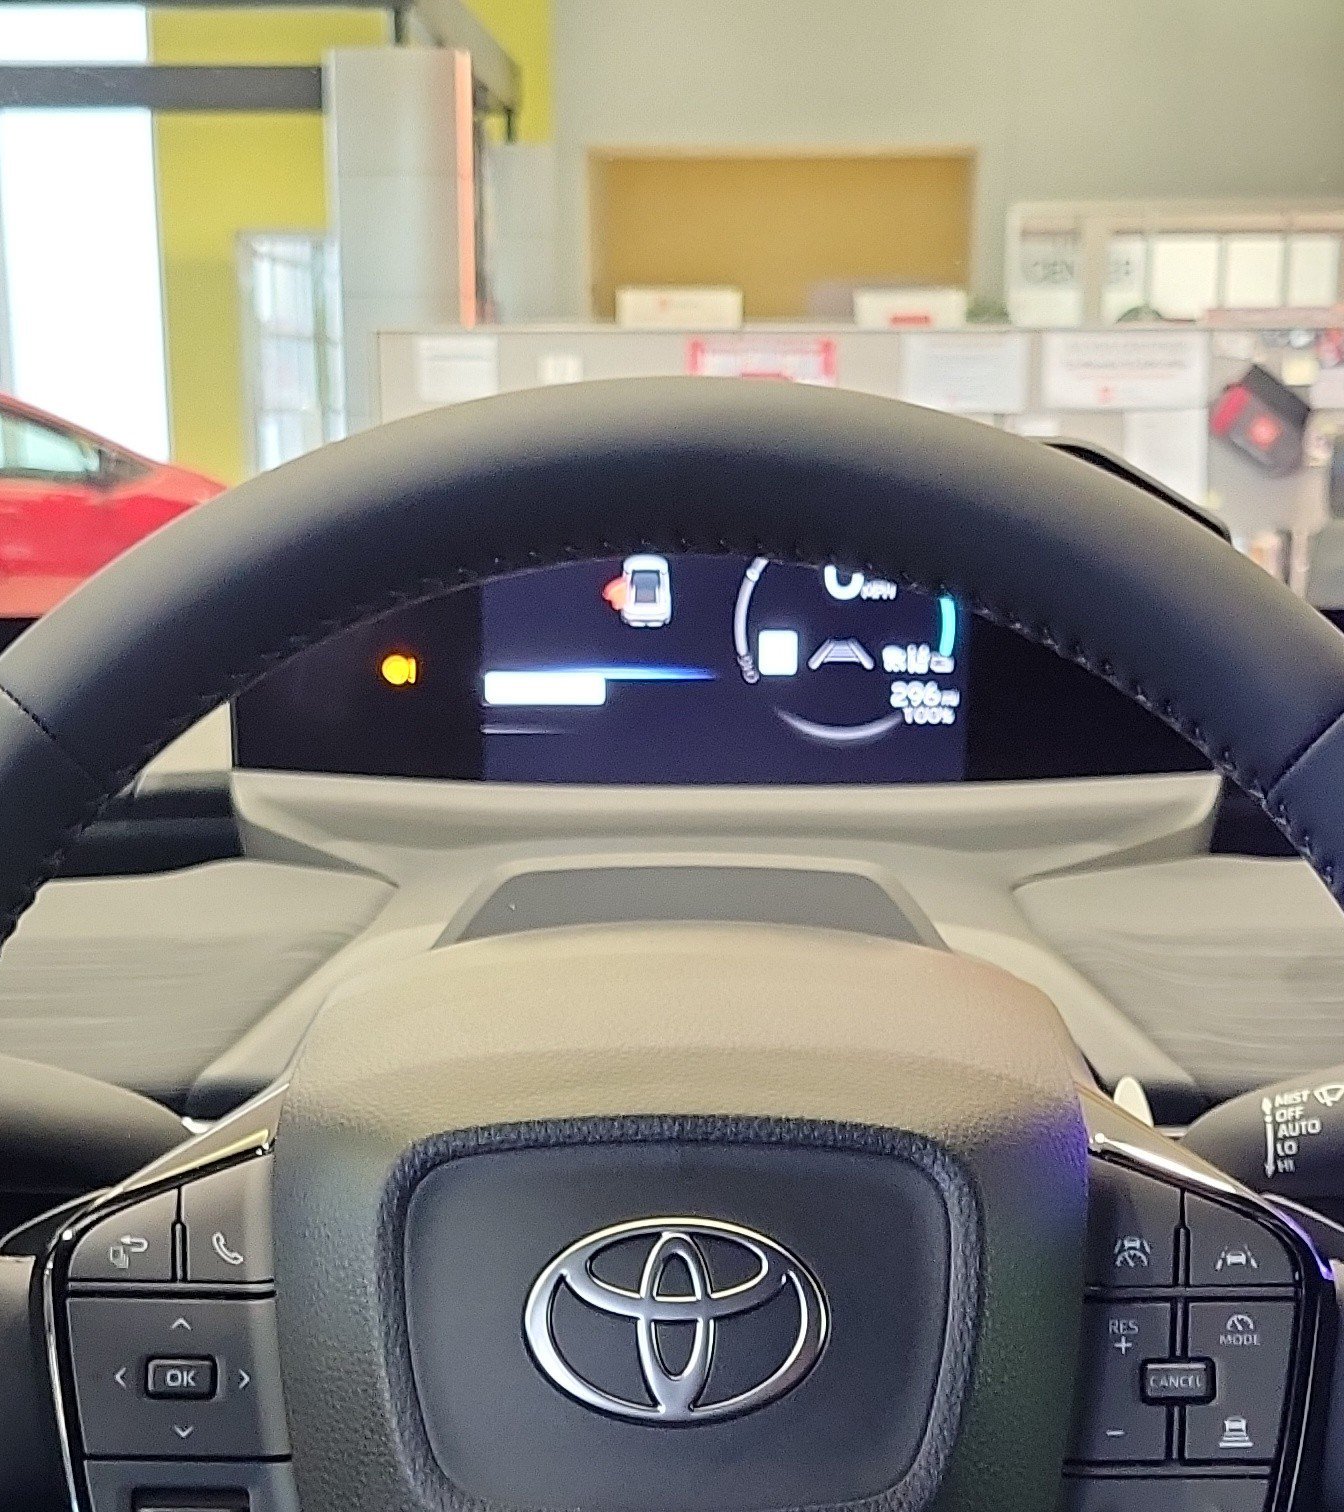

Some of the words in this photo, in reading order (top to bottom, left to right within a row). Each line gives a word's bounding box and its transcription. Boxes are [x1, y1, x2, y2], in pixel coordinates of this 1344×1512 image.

[890, 681, 941, 708] 296
[902, 706, 956, 725] 100%
[1274, 1090, 1310, 1107] MIST
[1275, 1106, 1304, 1123] OFF
[1276, 1119, 1321, 1138] AUTO
[1276, 1140, 1298, 1157] LO
[1276, 1158, 1296, 1173] HI
[1108, 1319, 1139, 1335] RES
[1219, 1334, 1260, 1346] MODE
[166, 1369, 196, 1387] OK
[1148, 1374, 1203, 1389] CANCEL
